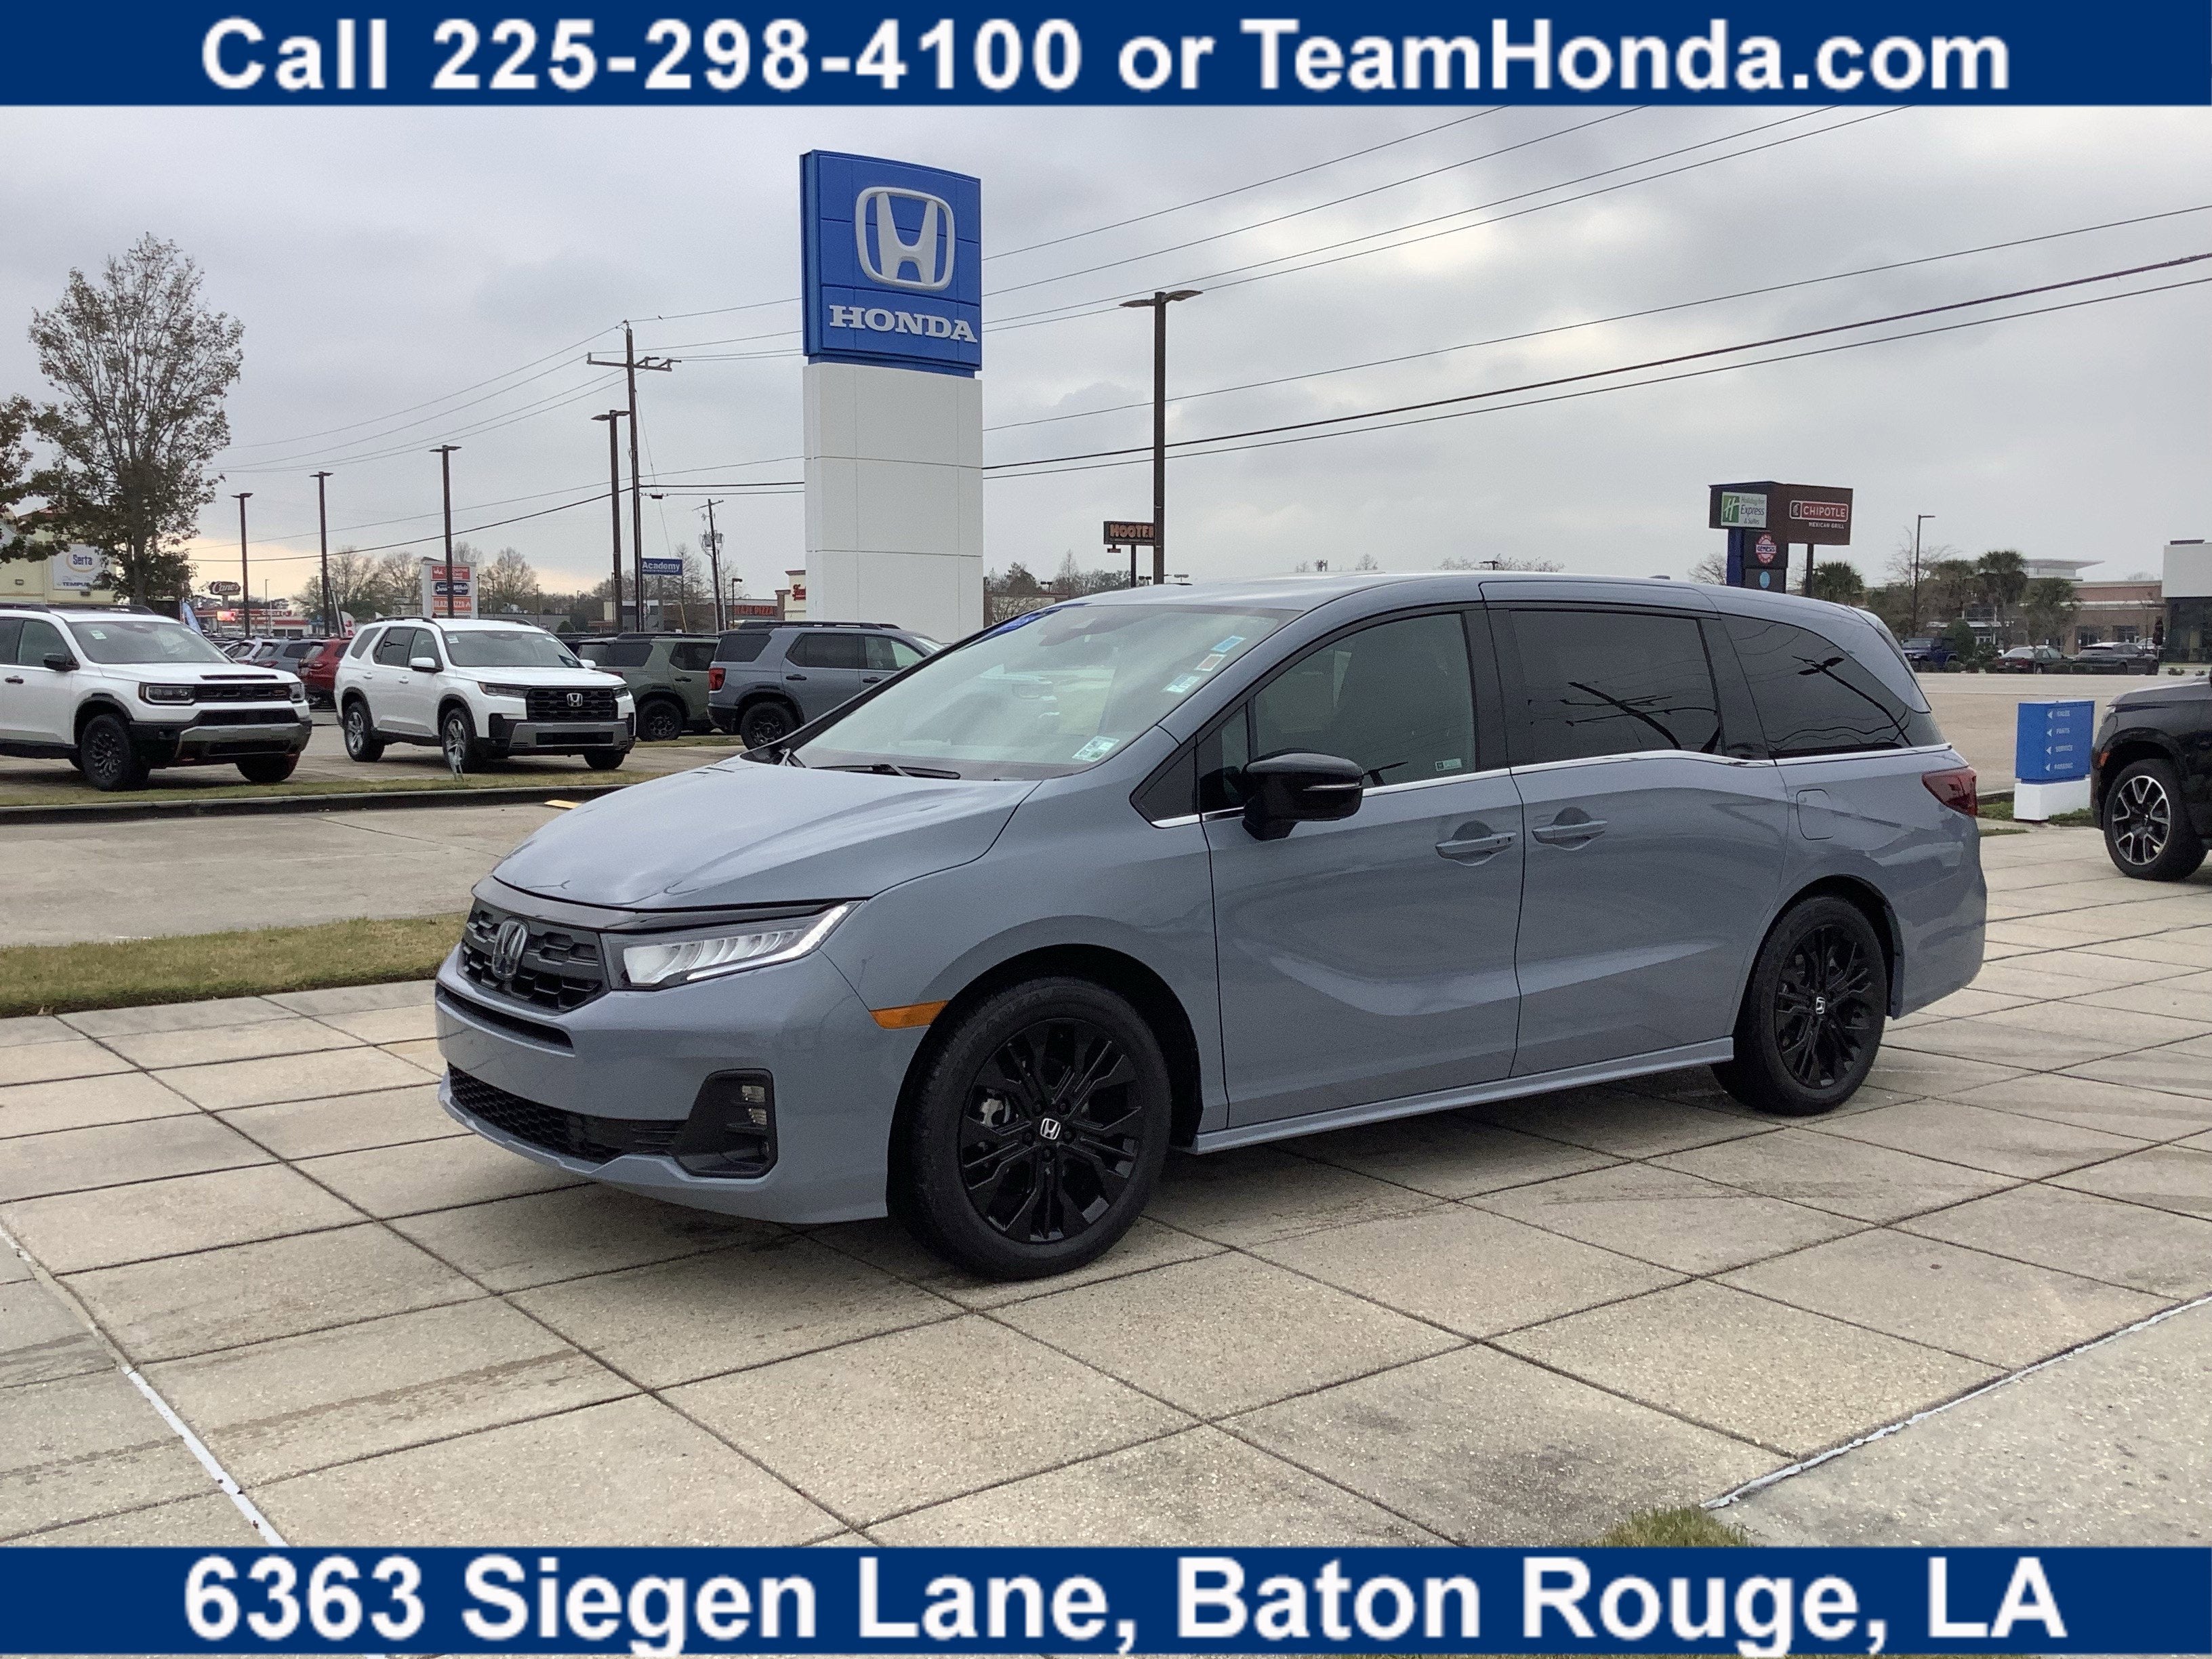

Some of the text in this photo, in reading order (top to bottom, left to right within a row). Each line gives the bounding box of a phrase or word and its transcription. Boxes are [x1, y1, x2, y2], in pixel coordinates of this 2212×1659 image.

[830, 305, 978, 343] HONDA
[1740, 504, 1765, 517] Express
[1803, 506, 1845, 517] CHIPOTLE
[1109, 524, 1153, 538] HOOTER
[73, 554, 93, 565] Serta
[642, 561, 680, 573] Academy
